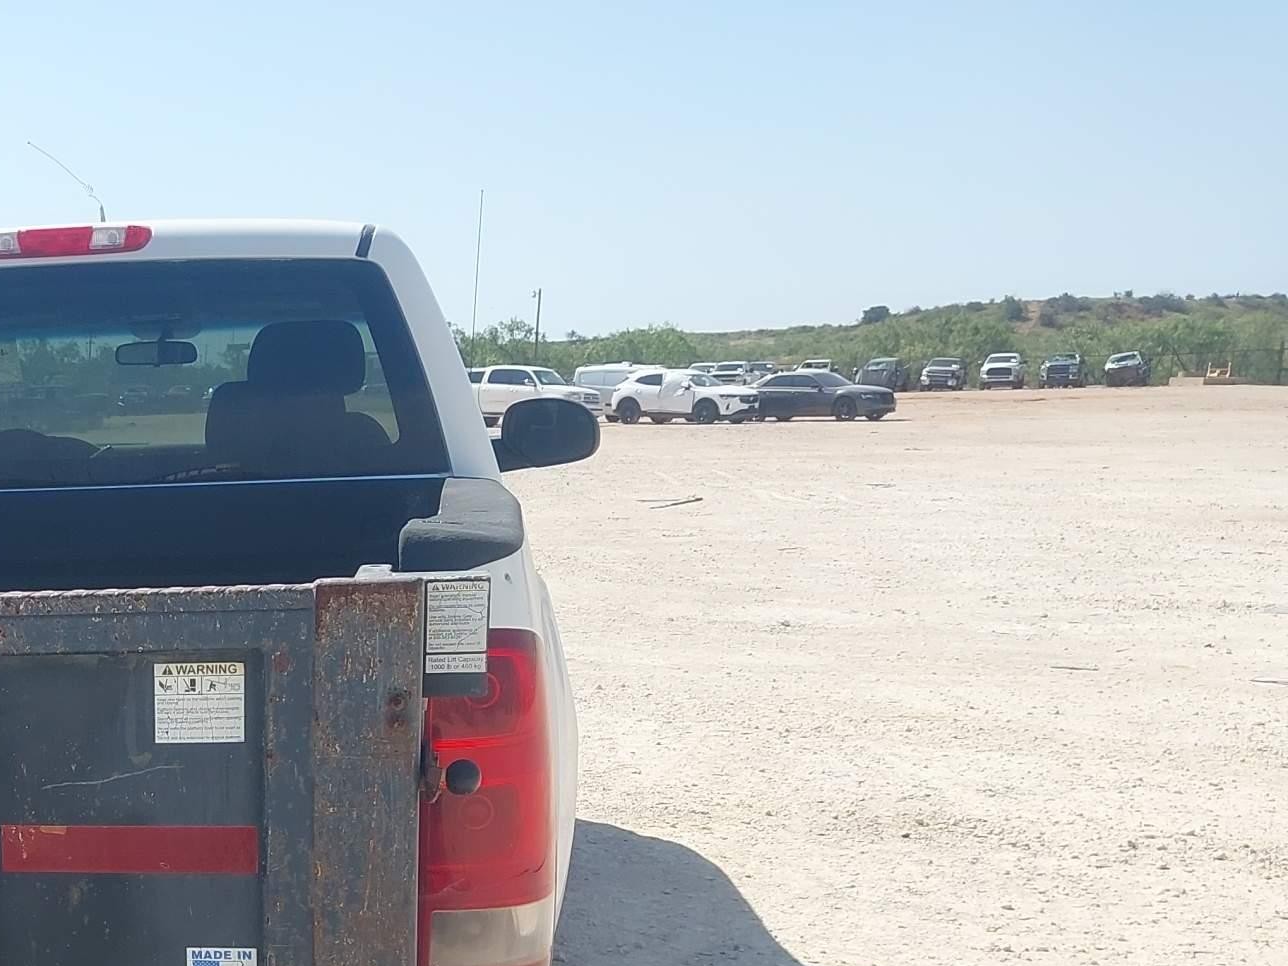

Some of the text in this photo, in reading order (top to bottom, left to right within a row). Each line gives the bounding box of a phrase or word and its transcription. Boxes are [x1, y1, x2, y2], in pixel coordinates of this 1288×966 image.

[176, 664, 238, 674] WARNING
[192, 950, 252, 960] MADE IN
